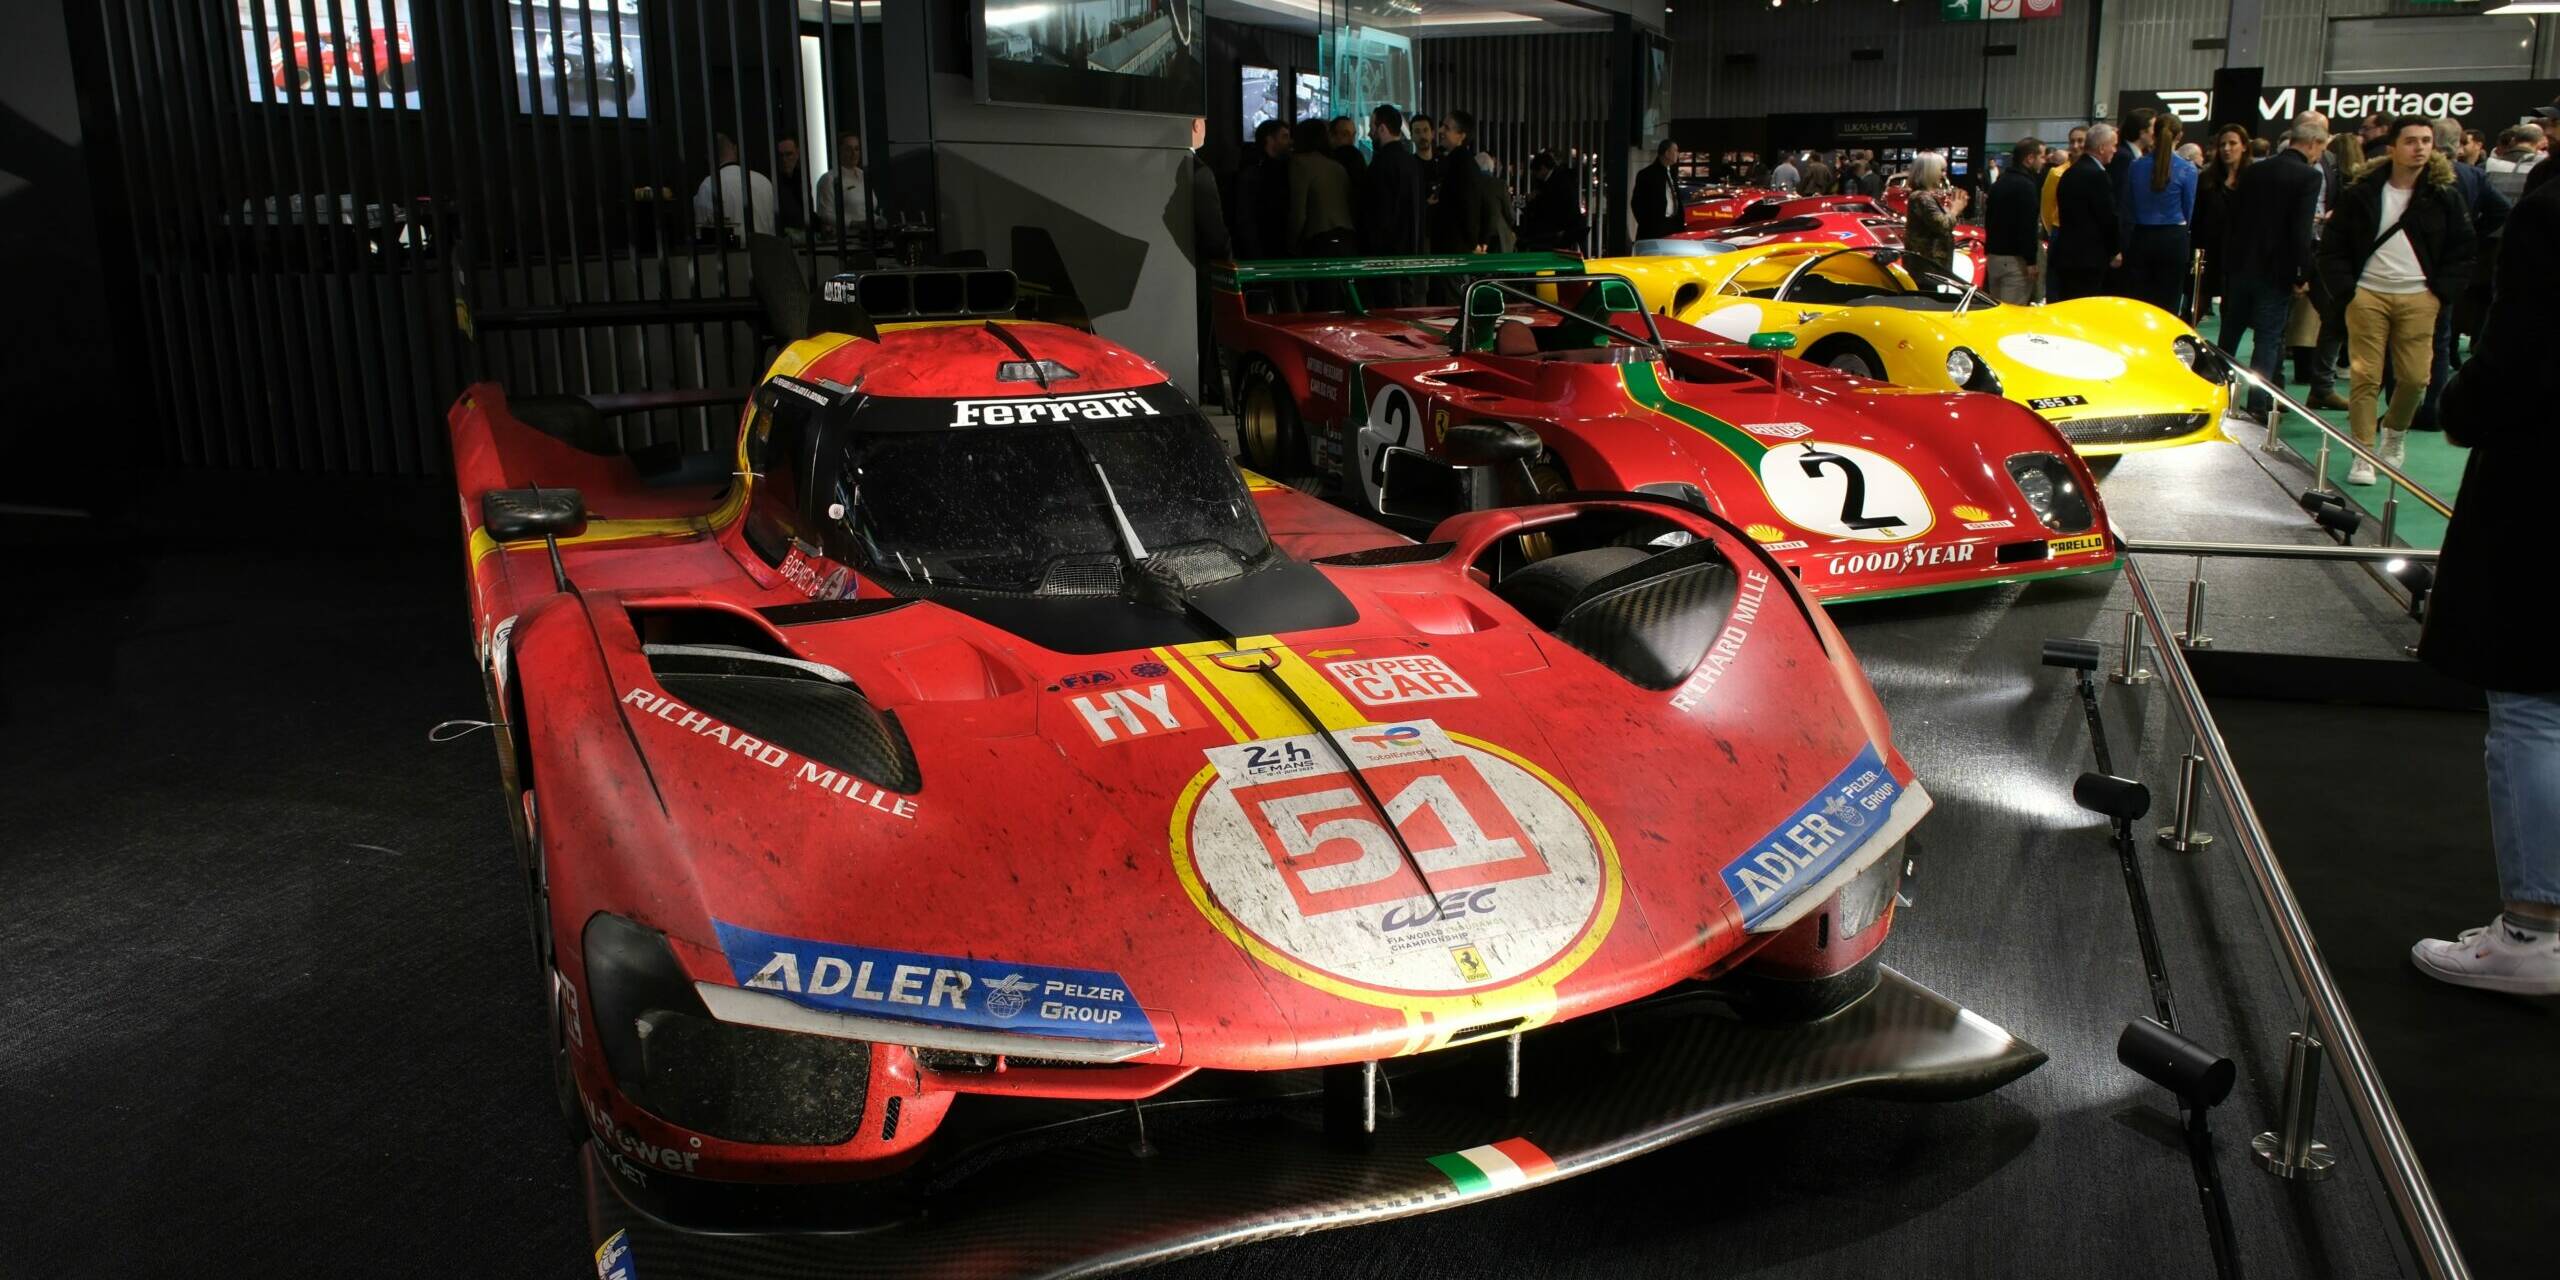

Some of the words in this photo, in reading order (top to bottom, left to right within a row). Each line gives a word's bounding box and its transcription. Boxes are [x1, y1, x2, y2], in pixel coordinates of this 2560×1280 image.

[2308, 84, 2474, 119] Heritage
[949, 390, 1161, 428] Ferrari
[2034, 397, 2066, 409] 365
[2067, 395, 2079, 405] P
[1371, 389, 1411, 488] 2
[1799, 451, 1908, 531] 2
[1733, 569, 1769, 625] MILLE
[1334, 658, 1443, 678] HYPER
[1352, 671, 1468, 701] CAR
[1071, 684, 1181, 742] HY
[621, 687, 789, 768] RICHARD
[797, 761, 919, 820] MILLE
[1249, 767, 1266, 775] LE
[1270, 760, 1314, 772] MANS
[1841, 770, 1880, 799] PELZER
[1860, 782, 1896, 811] GROUP
[1257, 775, 1527, 895] 51
[1735, 813, 1846, 906] ADLER
[1382, 887, 1497, 932] WEC
[1386, 935, 1405, 944] FIA
[1406, 929, 1444, 942] WORLD
[1391, 932, 1469, 952] CHAMPIONSHIP
[744, 951, 973, 1010] ADLER
[1044, 979, 1126, 1002] PELZER
[1040, 1000, 1122, 1025] GROUP
